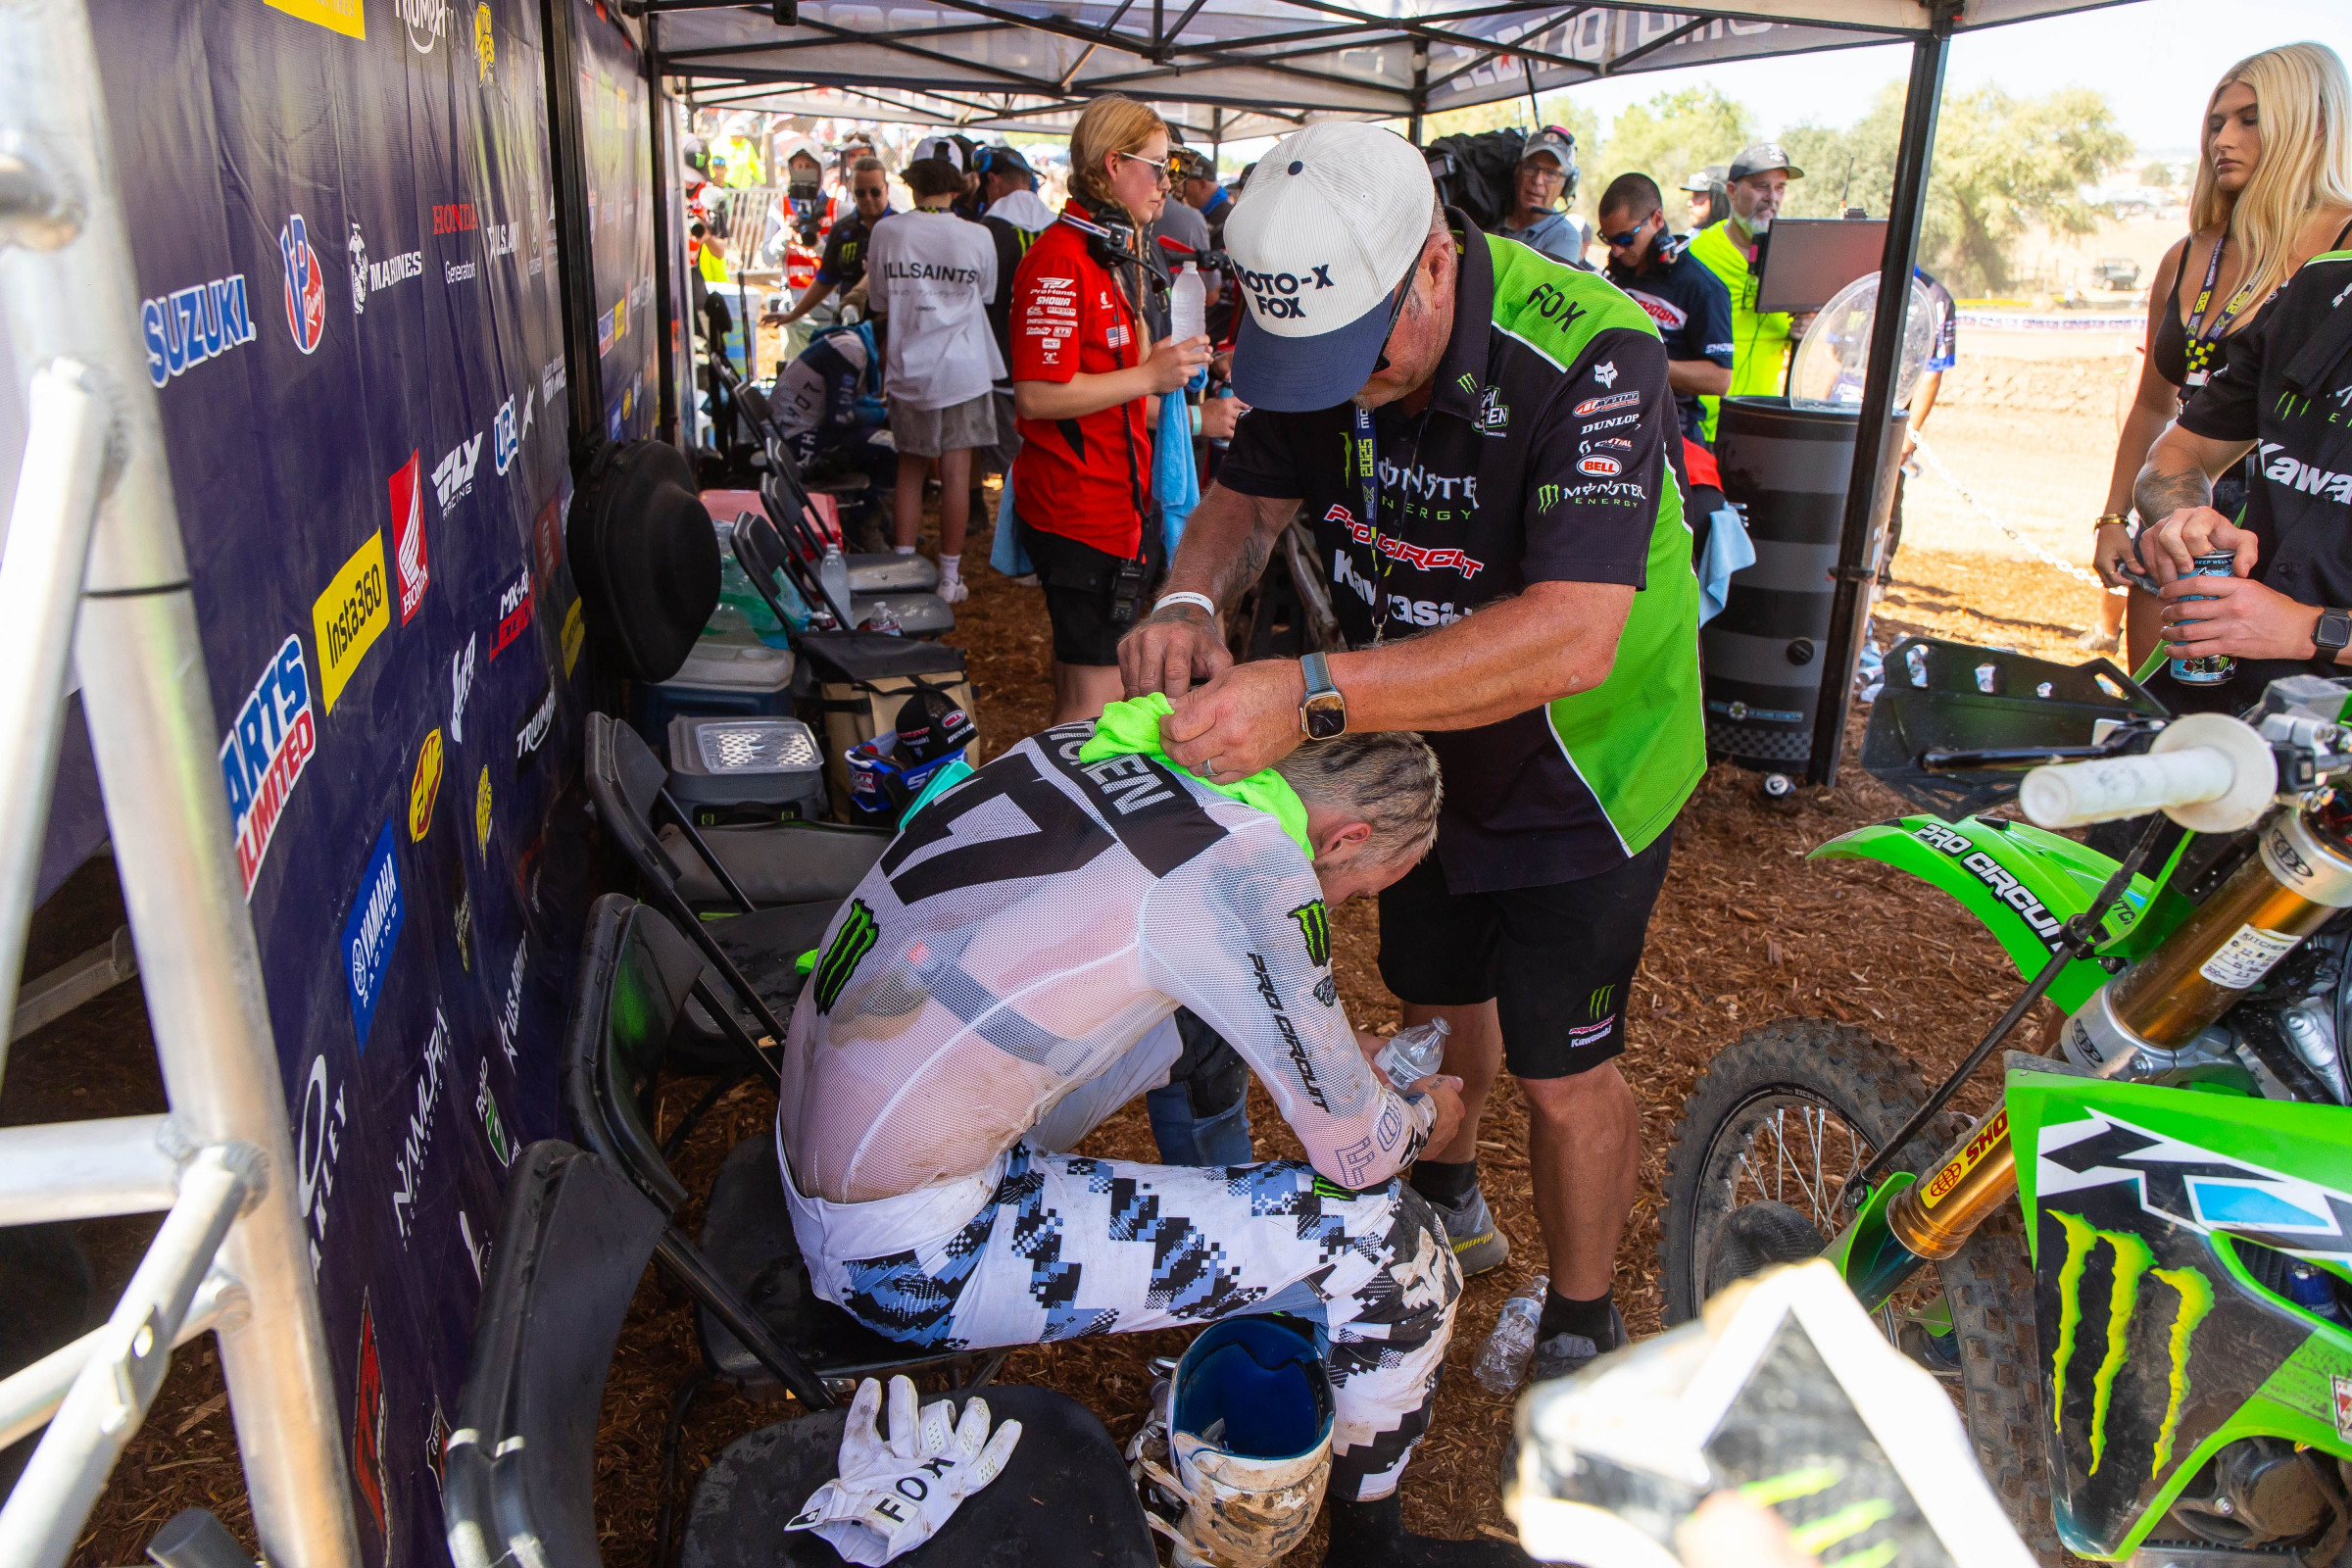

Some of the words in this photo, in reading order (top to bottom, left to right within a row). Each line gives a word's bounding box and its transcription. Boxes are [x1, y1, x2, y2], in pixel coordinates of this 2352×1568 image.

[432, 201, 478, 235] HONDA
[369, 251, 422, 292] MARINES
[445, 260, 476, 284] Generators
[1232, 259, 1335, 296] MOTO-X
[1035, 296, 1071, 307] SHOWA
[1254, 294, 1307, 319] FOX
[1527, 282, 1587, 333] FOX
[1639, 300, 1680, 325] HOWA
[140, 273, 252, 388] SUZUKI
[1705, 344, 1735, 354] SHOW
[1581, 413, 1640, 435] DUNLOP
[431, 431, 483, 508] FLY
[1357, 438, 1374, 477] 2025
[1585, 461, 1617, 473] BELL
[443, 482, 472, 521] RACING
[1382, 495, 1472, 520] NERGY
[1563, 480, 1646, 500] MONSTER
[1575, 497, 1638, 509] ENERGY
[403, 565, 429, 616] HONDA
[1334, 549, 1473, 627] Kawasa
[326, 562, 382, 669] Insta360
[220, 639, 308, 847] ARTS
[947, 722, 975, 745] DUNLO
[237, 710, 314, 900] LIMITED
[1913, 823, 1974, 856] PRO
[361, 853, 397, 965] YAMAHA
[363, 903, 398, 1008] RACING
[1248, 952, 1284, 1011] PRO
[1274, 1013, 1331, 1114] CIRCUIT
[1571, 1025, 1612, 1048] Kawasaki
[1966, 1109, 2008, 1166] SHO
[310, 1080, 346, 1287] AKLEY
[874, 1456, 956, 1524] FOX
